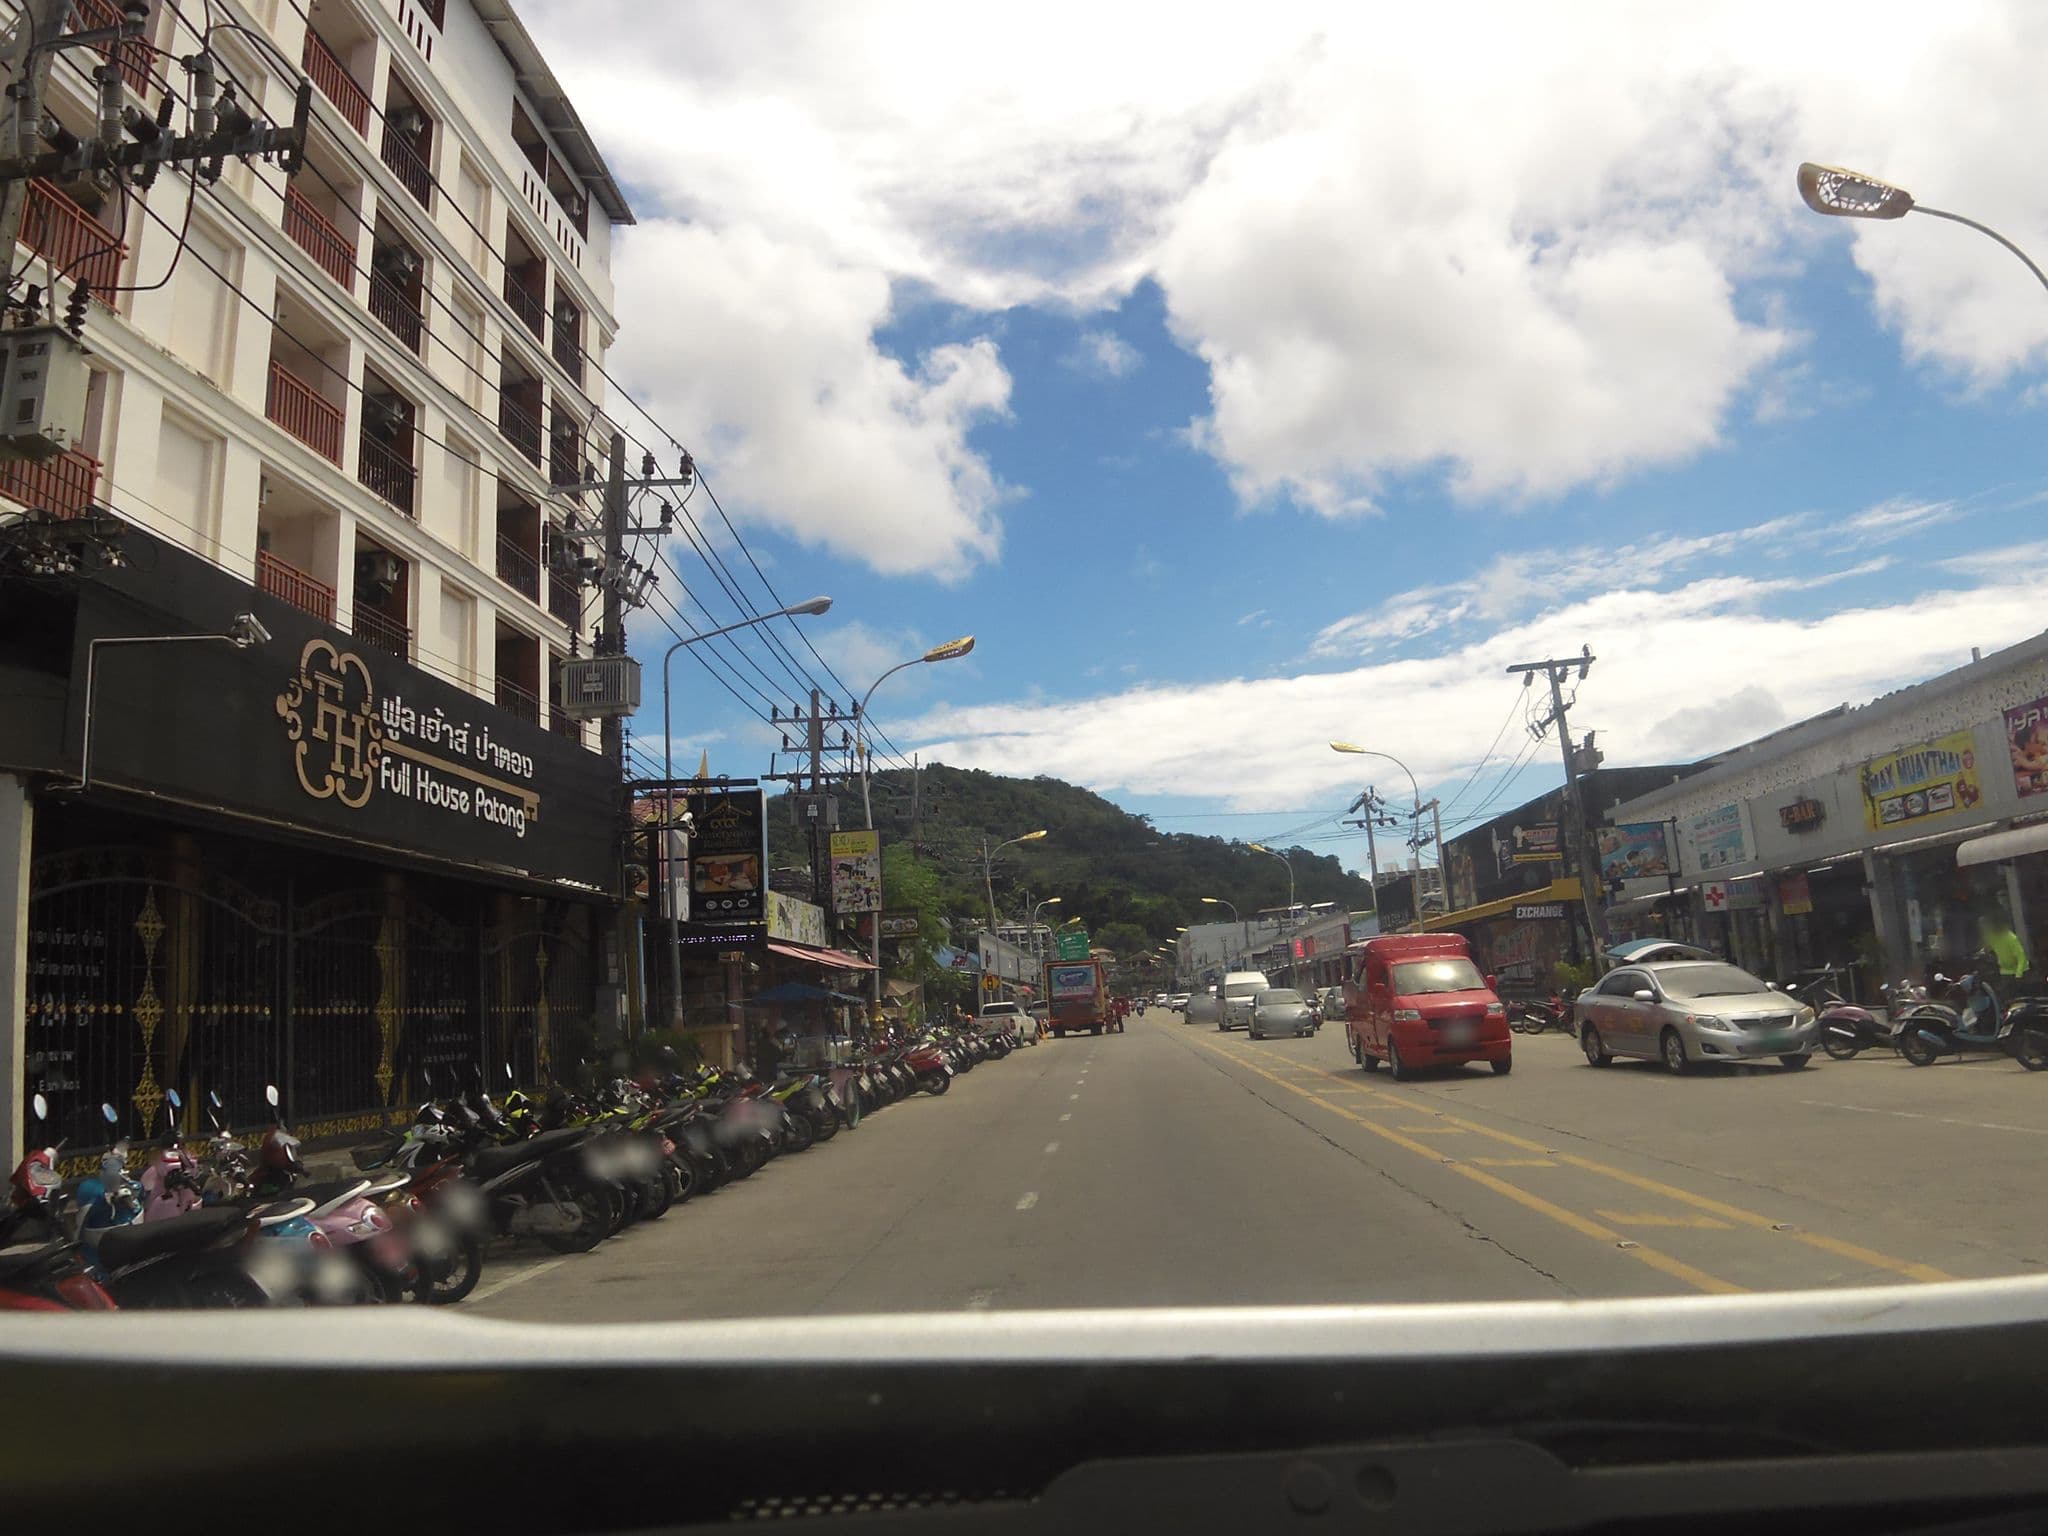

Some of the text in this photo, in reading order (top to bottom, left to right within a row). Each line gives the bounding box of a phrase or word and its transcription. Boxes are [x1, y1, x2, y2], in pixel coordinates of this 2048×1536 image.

[382, 696, 415, 741] ฟูล
[475, 726, 533, 778] ป่าตอง
[380, 756, 526, 838] Full House Patong
[1516, 904, 1564, 919] EXCHANGE
